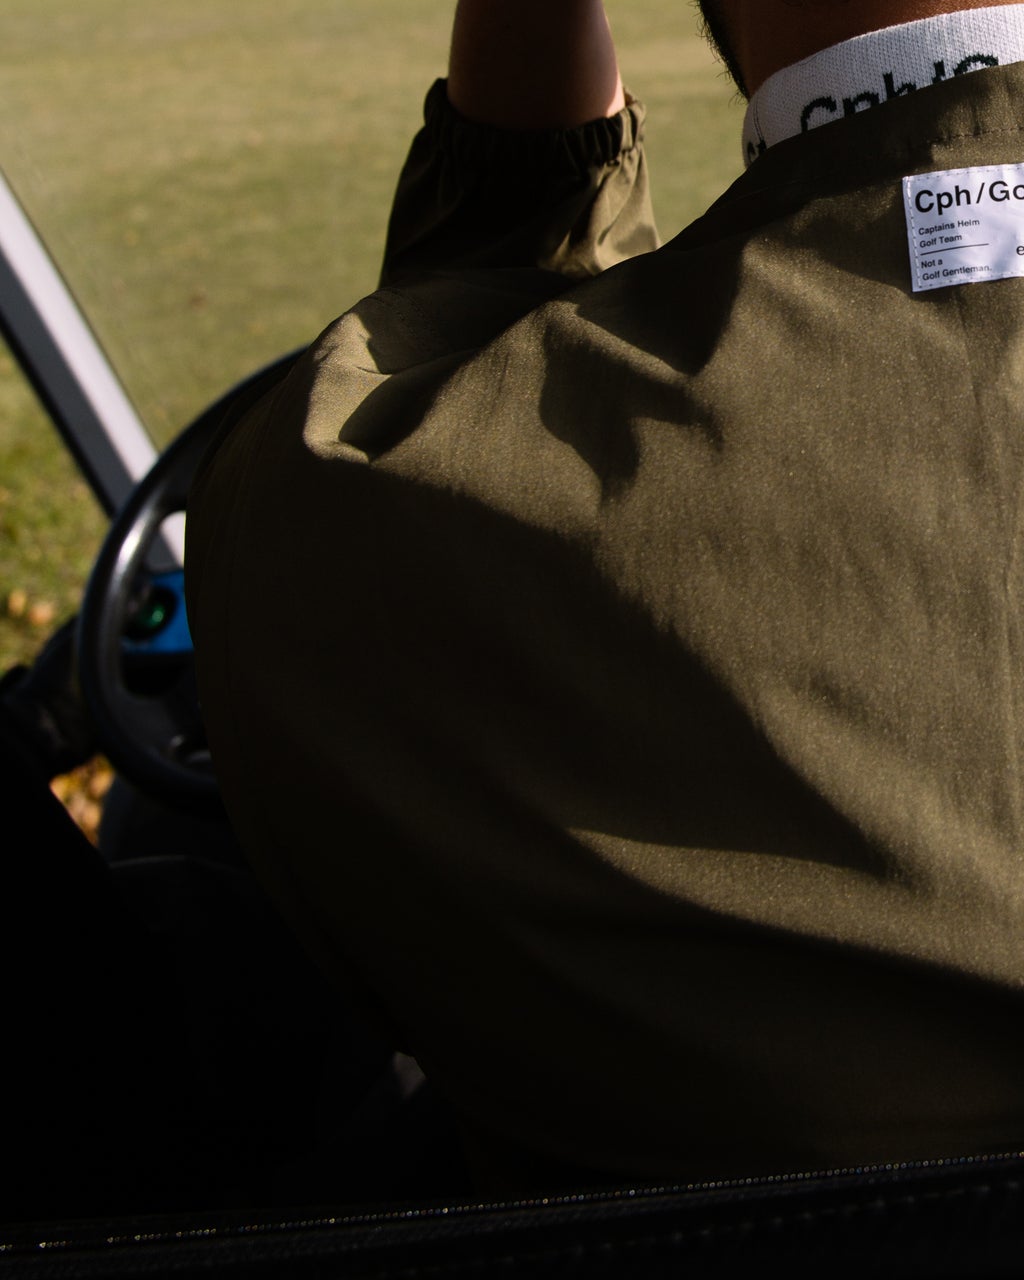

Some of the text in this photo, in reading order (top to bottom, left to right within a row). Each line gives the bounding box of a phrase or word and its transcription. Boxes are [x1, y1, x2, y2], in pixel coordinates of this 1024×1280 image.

[919, 223, 955, 236] Captains
[920, 235, 963, 250] Golf Team
[920, 259, 944, 269] Not a
[922, 271, 940, 281] Golf
